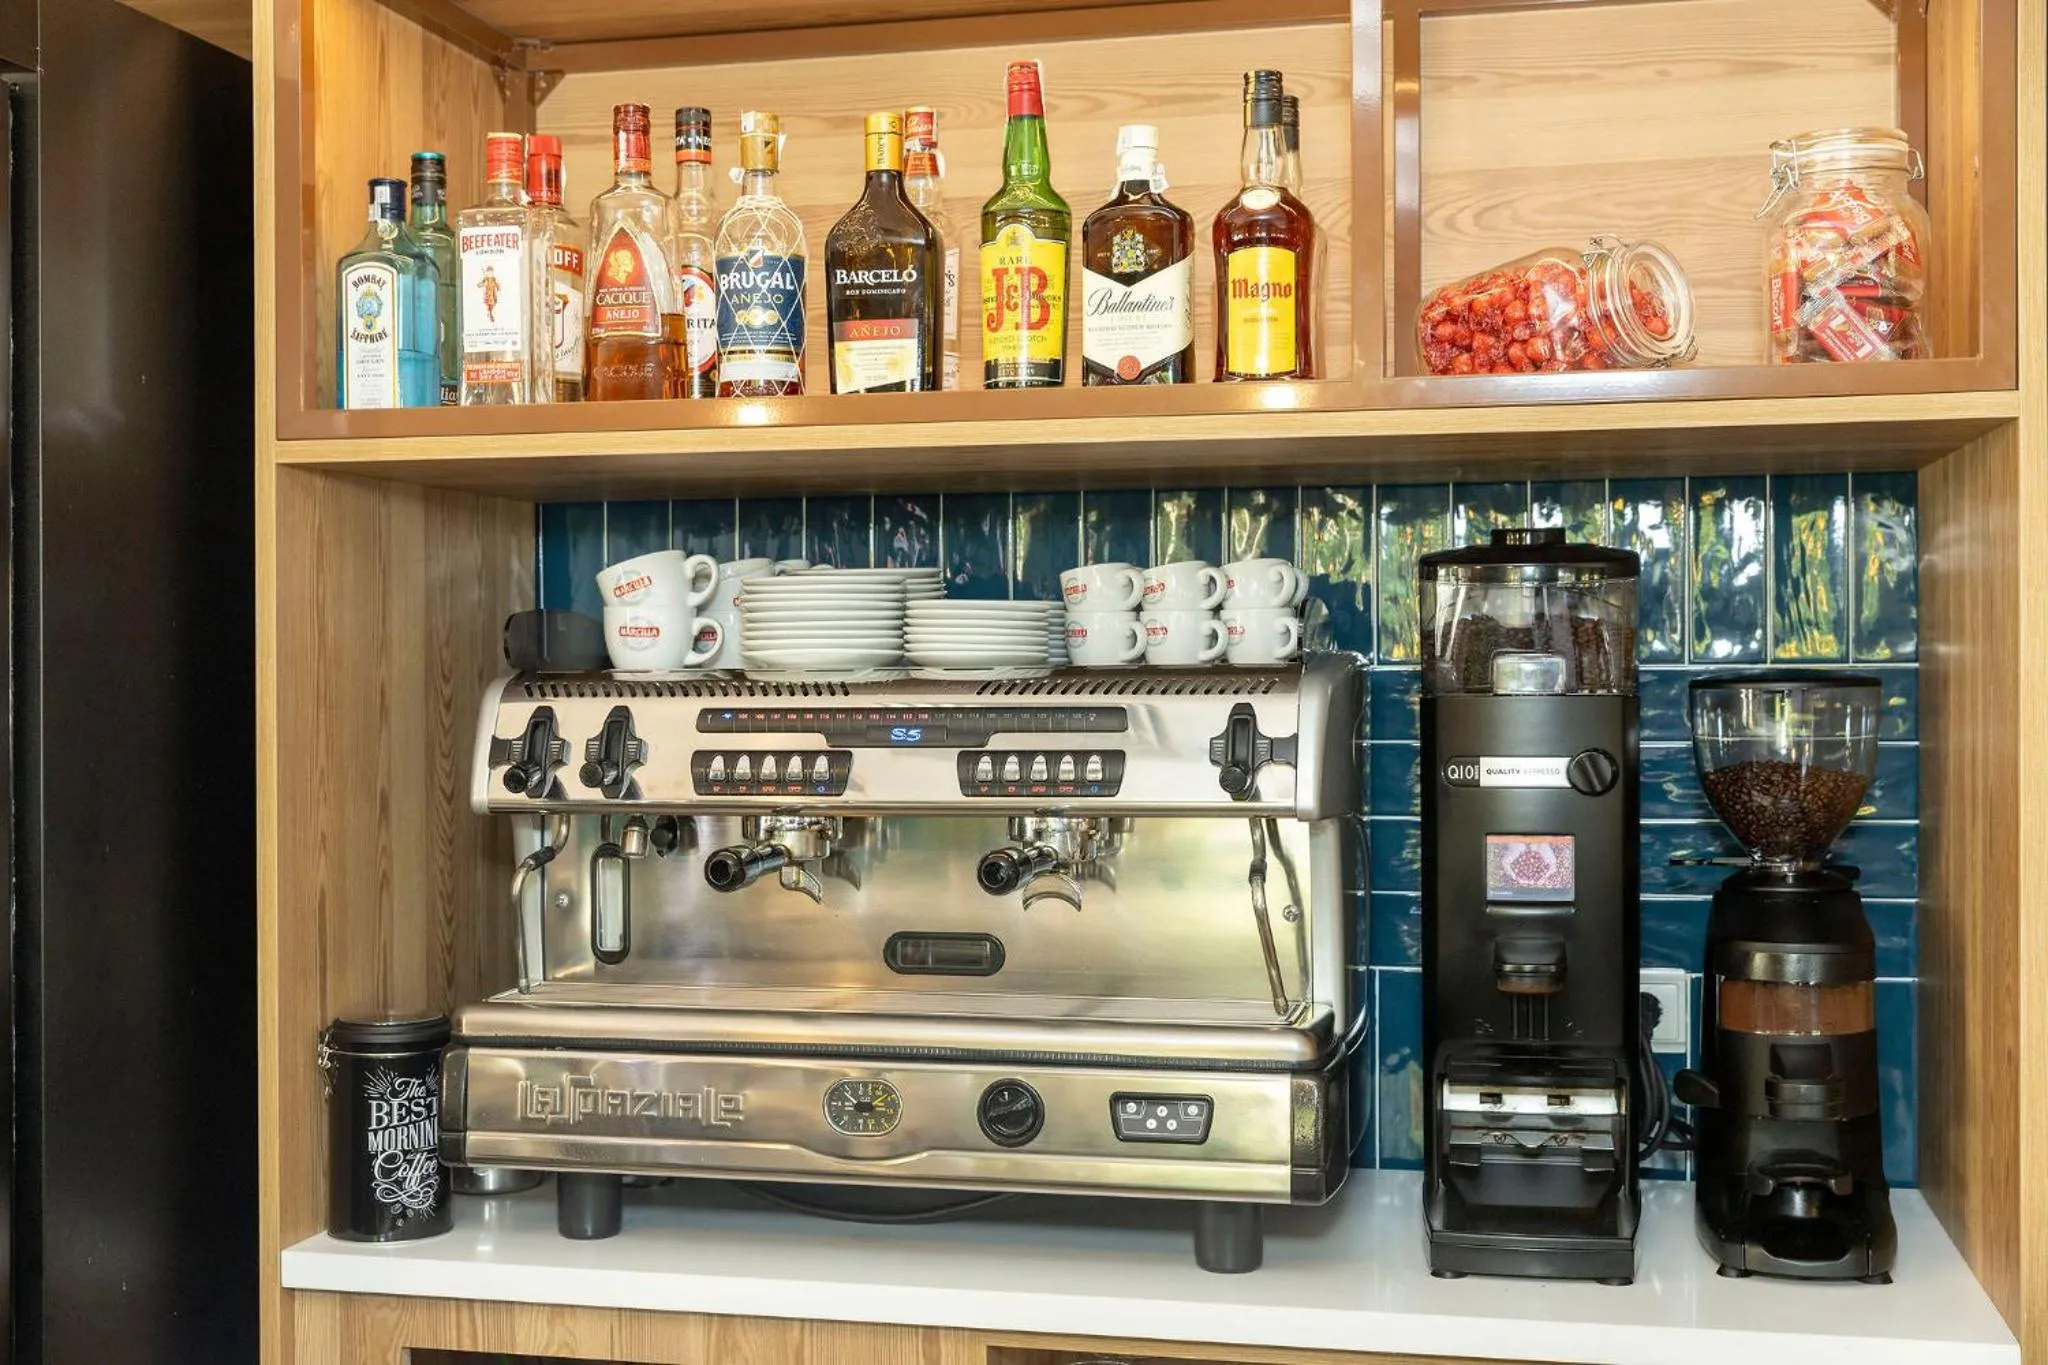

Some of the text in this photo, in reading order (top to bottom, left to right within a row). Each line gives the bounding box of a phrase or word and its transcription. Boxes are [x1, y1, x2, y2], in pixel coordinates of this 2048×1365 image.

[461, 232, 520, 254] BEEFEATER
[554, 248, 579, 269] OFF
[351, 274, 387, 291] BOMBAY
[719, 271, 795, 290] BRUGAL
[835, 264, 918, 286] BARCELÓ
[596, 291, 651, 306] CACIQUE
[731, 291, 784, 304] AÑEJO
[1231, 277, 1292, 303] Magno
[986, 266, 1051, 333] J&B
[606, 309, 640, 320] AÑEJO
[686, 318, 716, 329] RITA
[349, 326, 390, 344] SAPPHIRE
[849, 324, 901, 338] AÑEJO
[619, 626, 660, 637] MARCILLA
[891, 727, 922, 742] S5
[1486, 767, 1521, 775] QUALITY
[386, 1077, 428, 1101] The
[367, 1096, 438, 1130] BEST
[367, 1116, 438, 1153] MORNIN
[373, 1150, 438, 1190] Coffee
